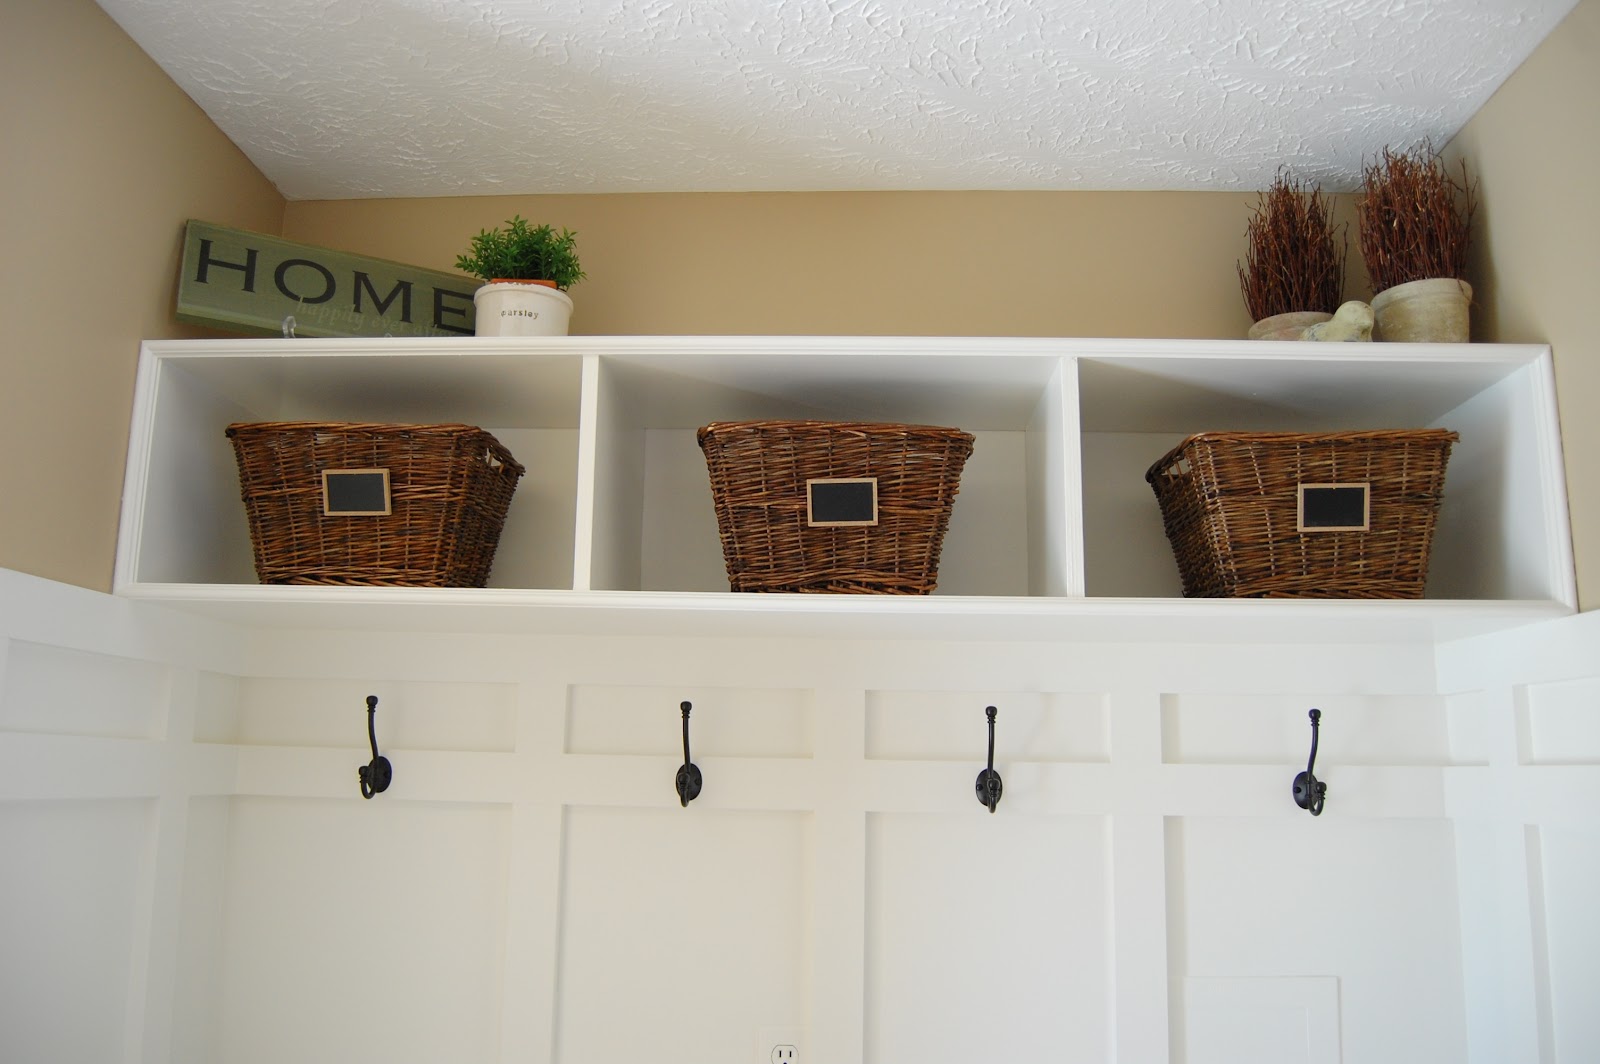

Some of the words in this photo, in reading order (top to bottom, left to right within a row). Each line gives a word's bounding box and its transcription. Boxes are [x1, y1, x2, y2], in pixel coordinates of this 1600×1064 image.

[194, 238, 476, 335] HOME
[295, 294, 366, 330] happily
[371, 315, 409, 333] ever
[500, 309, 539, 320] parsley
